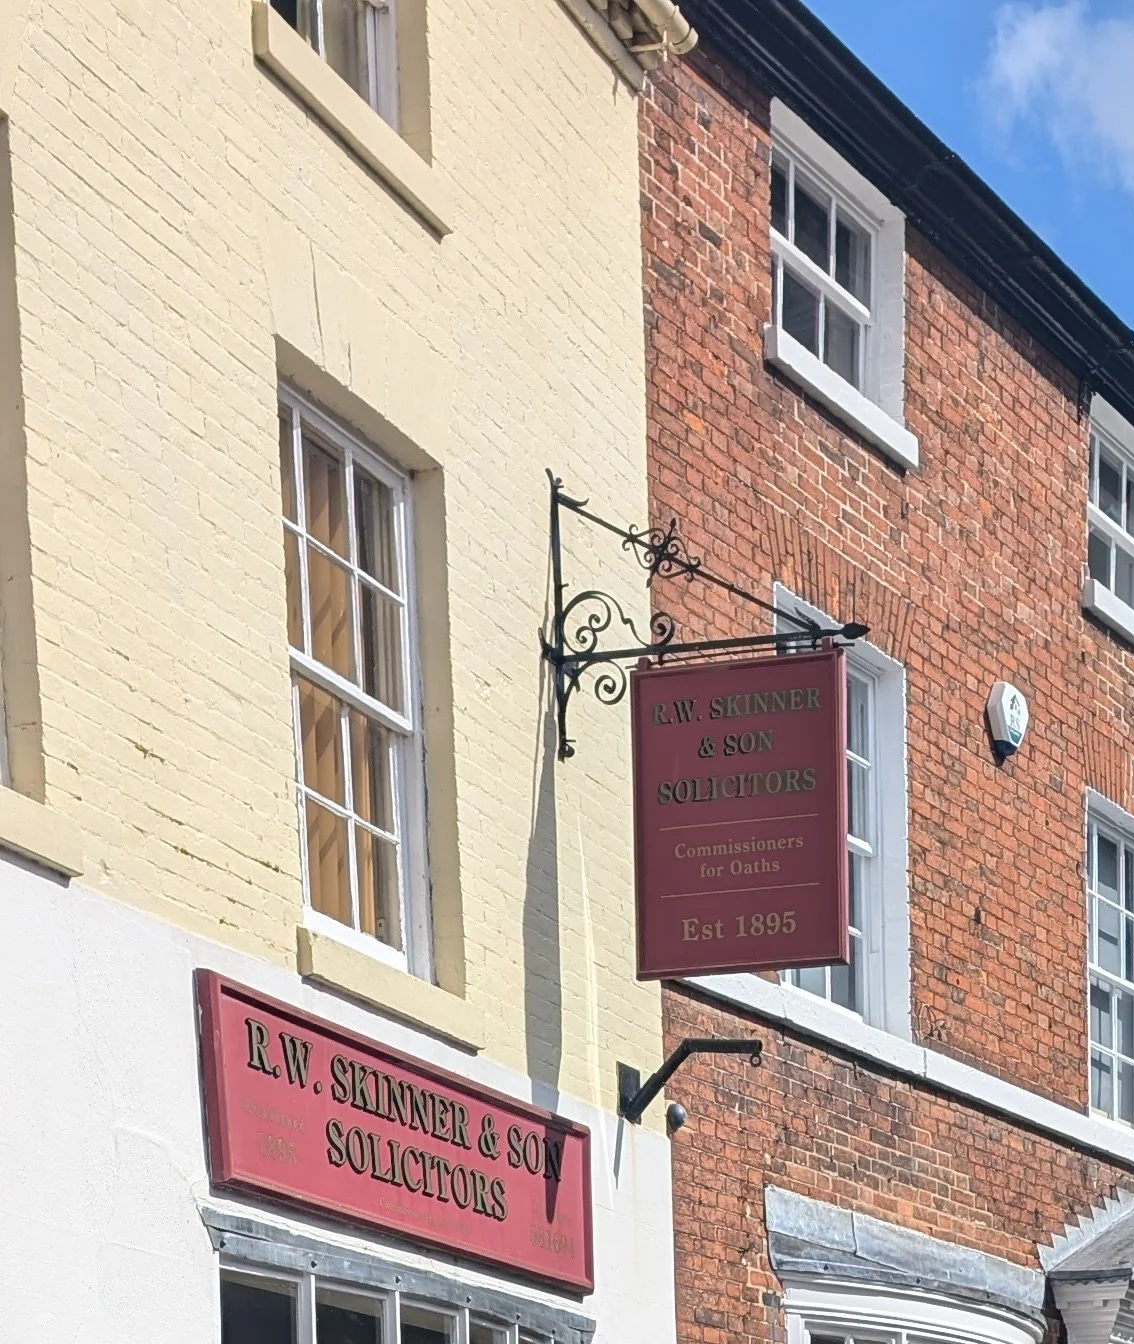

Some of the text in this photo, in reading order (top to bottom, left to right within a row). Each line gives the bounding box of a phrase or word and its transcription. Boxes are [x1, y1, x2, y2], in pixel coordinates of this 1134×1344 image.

[709, 687, 821, 720] SKINNER
[698, 730, 773, 758] & SON
[658, 768, 817, 805] SOLICITORS
[675, 834, 804, 860] Commissioners
[699, 859, 780, 878] for Oaths
[681, 911, 797, 942] Est 1895
[330, 1054, 471, 1149] SKINNER
[477, 1114, 501, 1159] &
[507, 1124, 563, 1181] SON
[326, 1118, 508, 1222] SOLICITORS
